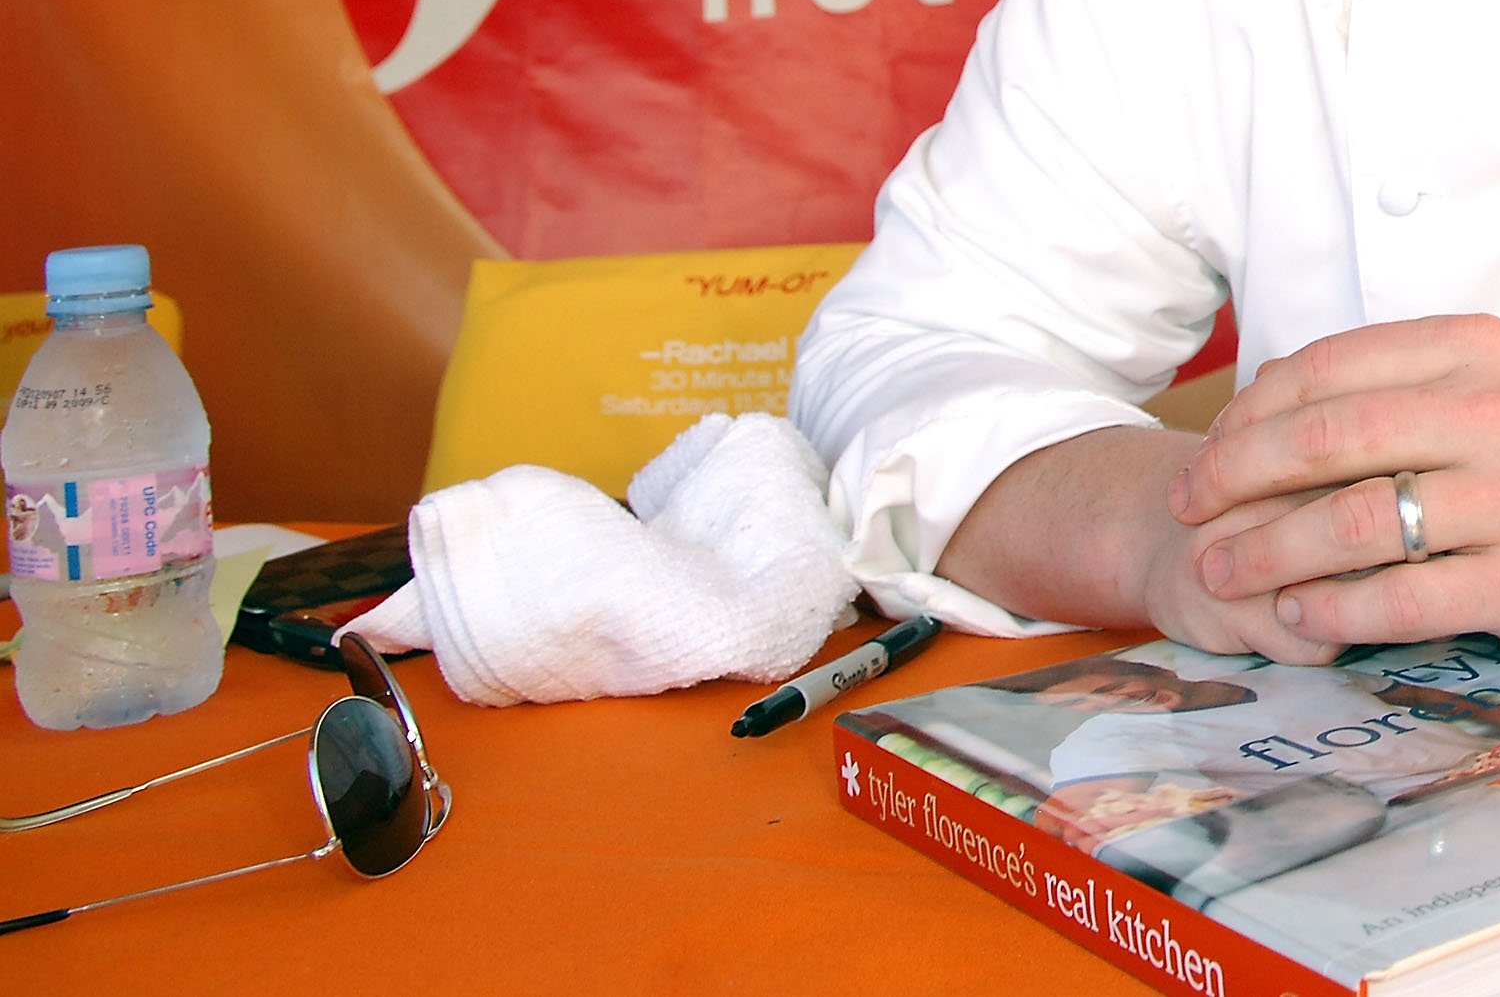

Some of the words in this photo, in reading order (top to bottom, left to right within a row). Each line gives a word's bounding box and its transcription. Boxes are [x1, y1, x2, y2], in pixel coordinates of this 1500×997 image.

[651, 369, 688, 391] 30
[692, 367, 772, 389] Minute
[601, 393, 731, 417] Saturdays
[143, 486, 157, 516] UPC
[144, 520, 157, 558] Code
[867, 766, 917, 827] tyler
[922, 791, 1038, 898] florence's
[1043, 870, 1100, 934] real
[1104, 888, 1226, 997] kitchen
[1361, 914, 1402, 937] An
